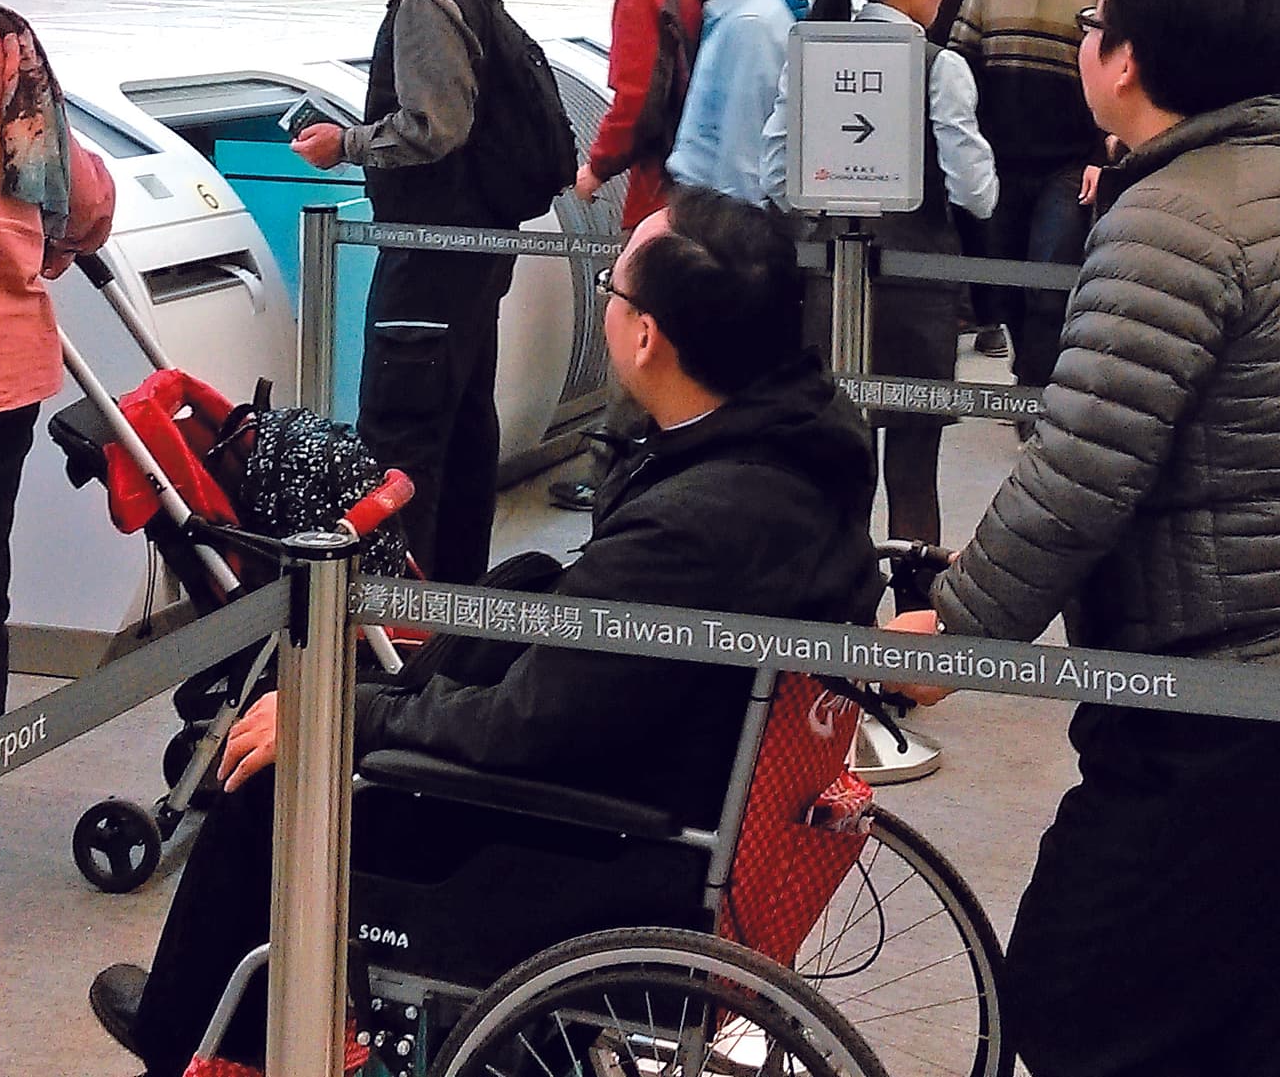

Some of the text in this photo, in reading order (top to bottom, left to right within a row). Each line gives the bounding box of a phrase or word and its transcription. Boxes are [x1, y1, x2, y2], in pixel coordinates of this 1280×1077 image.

[834, 69, 883, 94] 出口
[196, 183, 220, 210] 6
[367, 225, 415, 242] Taiwan
[417, 228, 476, 249] Taoyuan
[478, 231, 568, 252] International
[979, 389, 1045, 413] Taiwa
[590, 608, 693, 646] Taiwan
[702, 619, 831, 663] Taoyuan
[842, 635, 1046, 684] International
[1054, 656, 1177, 700] Airport
[358, 924, 409, 949] SOMA
